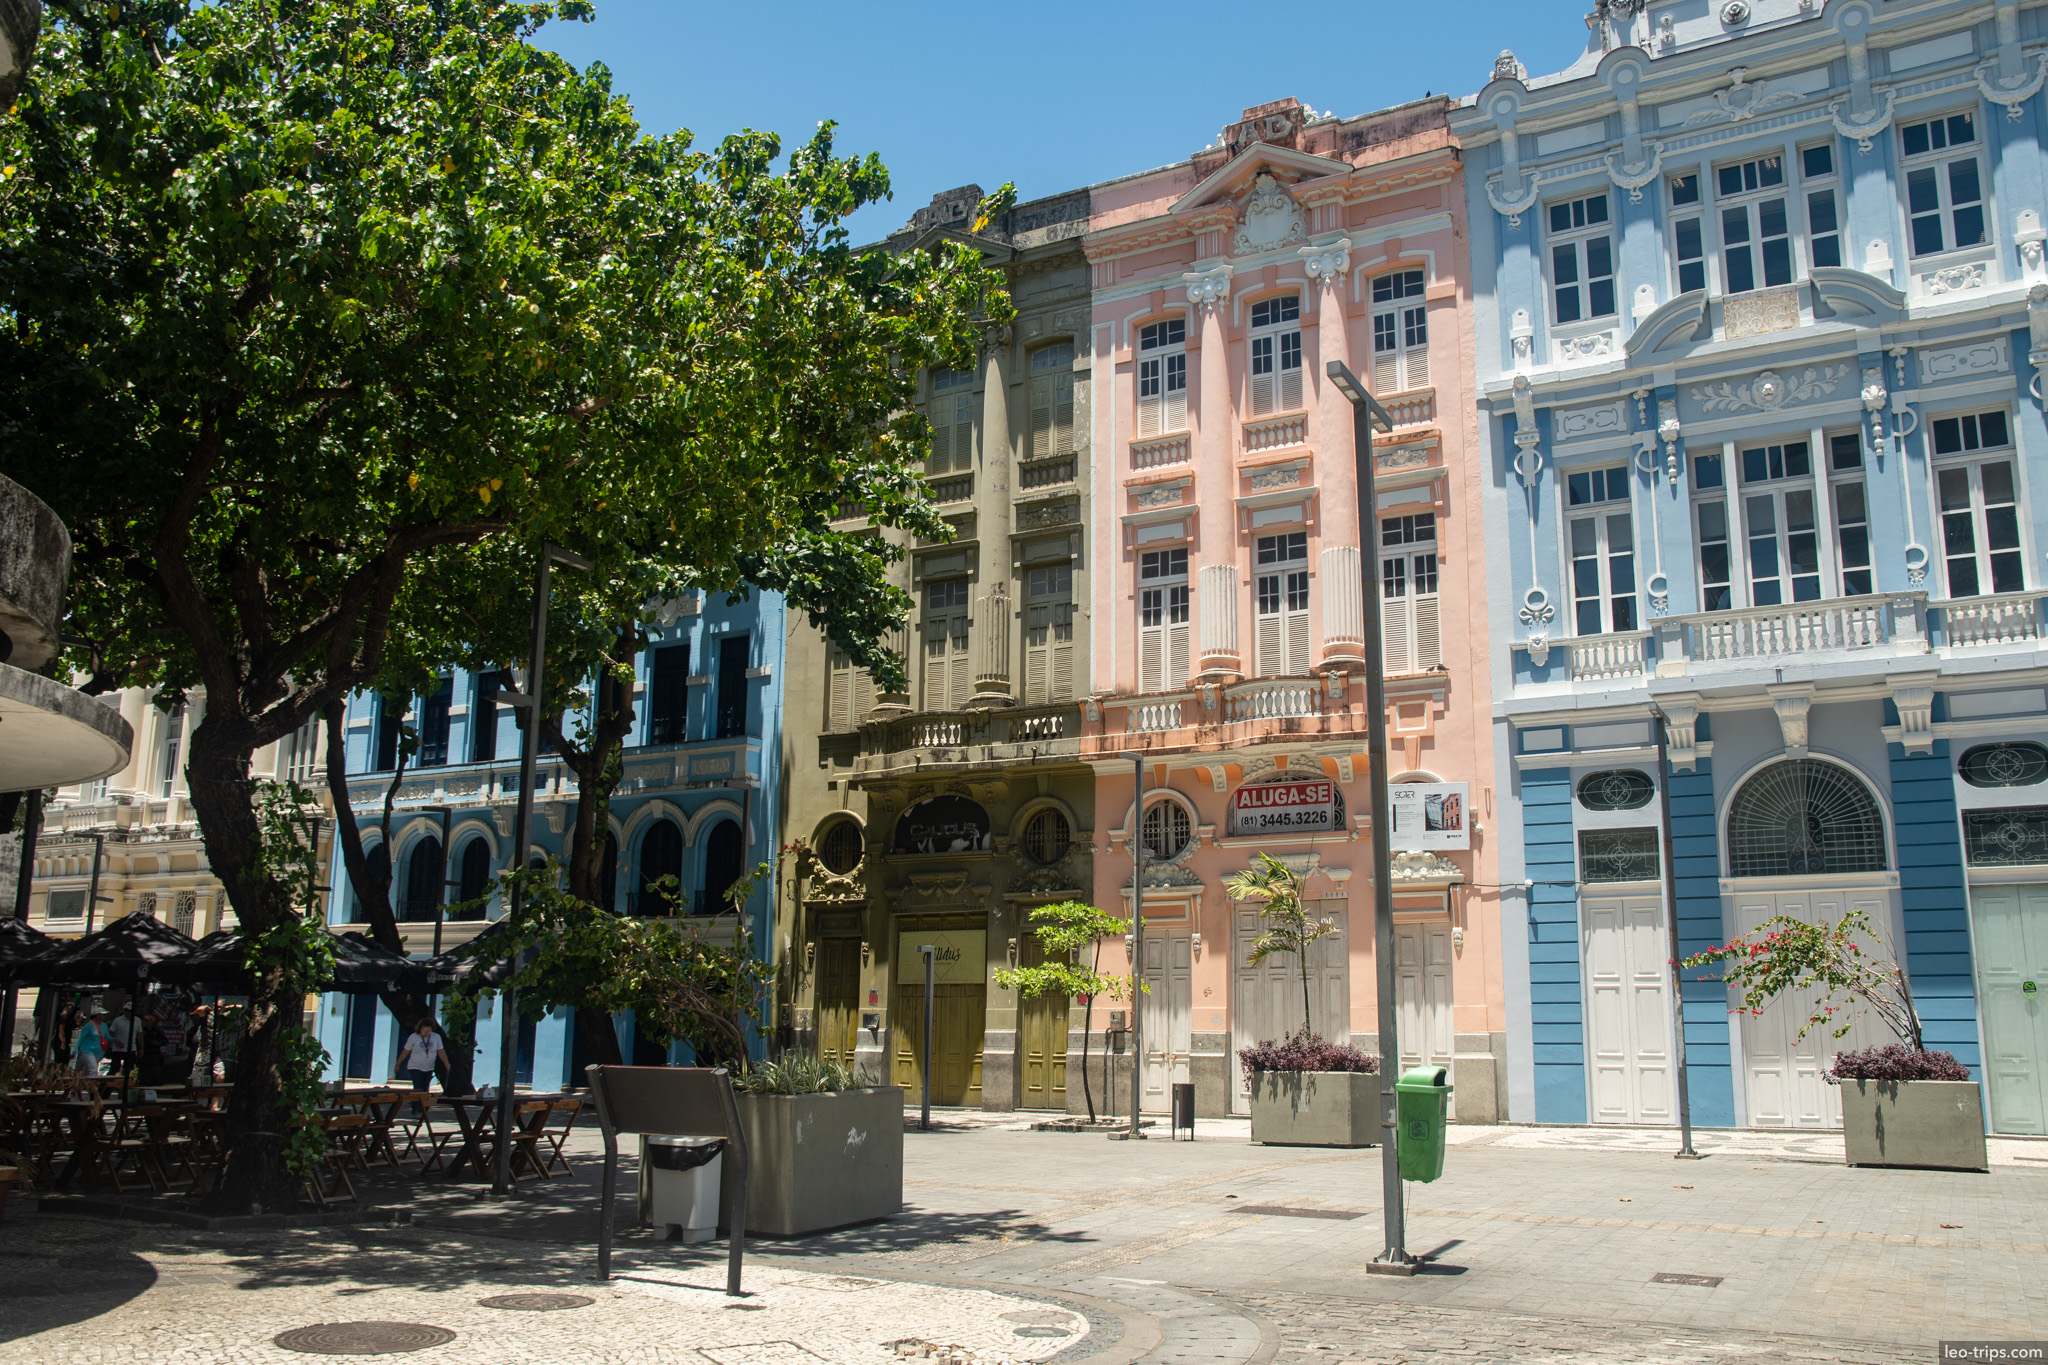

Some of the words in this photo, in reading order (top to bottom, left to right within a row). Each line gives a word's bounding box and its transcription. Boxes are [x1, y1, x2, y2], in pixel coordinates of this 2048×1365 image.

[1239, 785, 1329, 807] ALUGA-SE
[1241, 815, 1258, 827] (81)
[1260, 810, 1328, 827] 3445.3226
